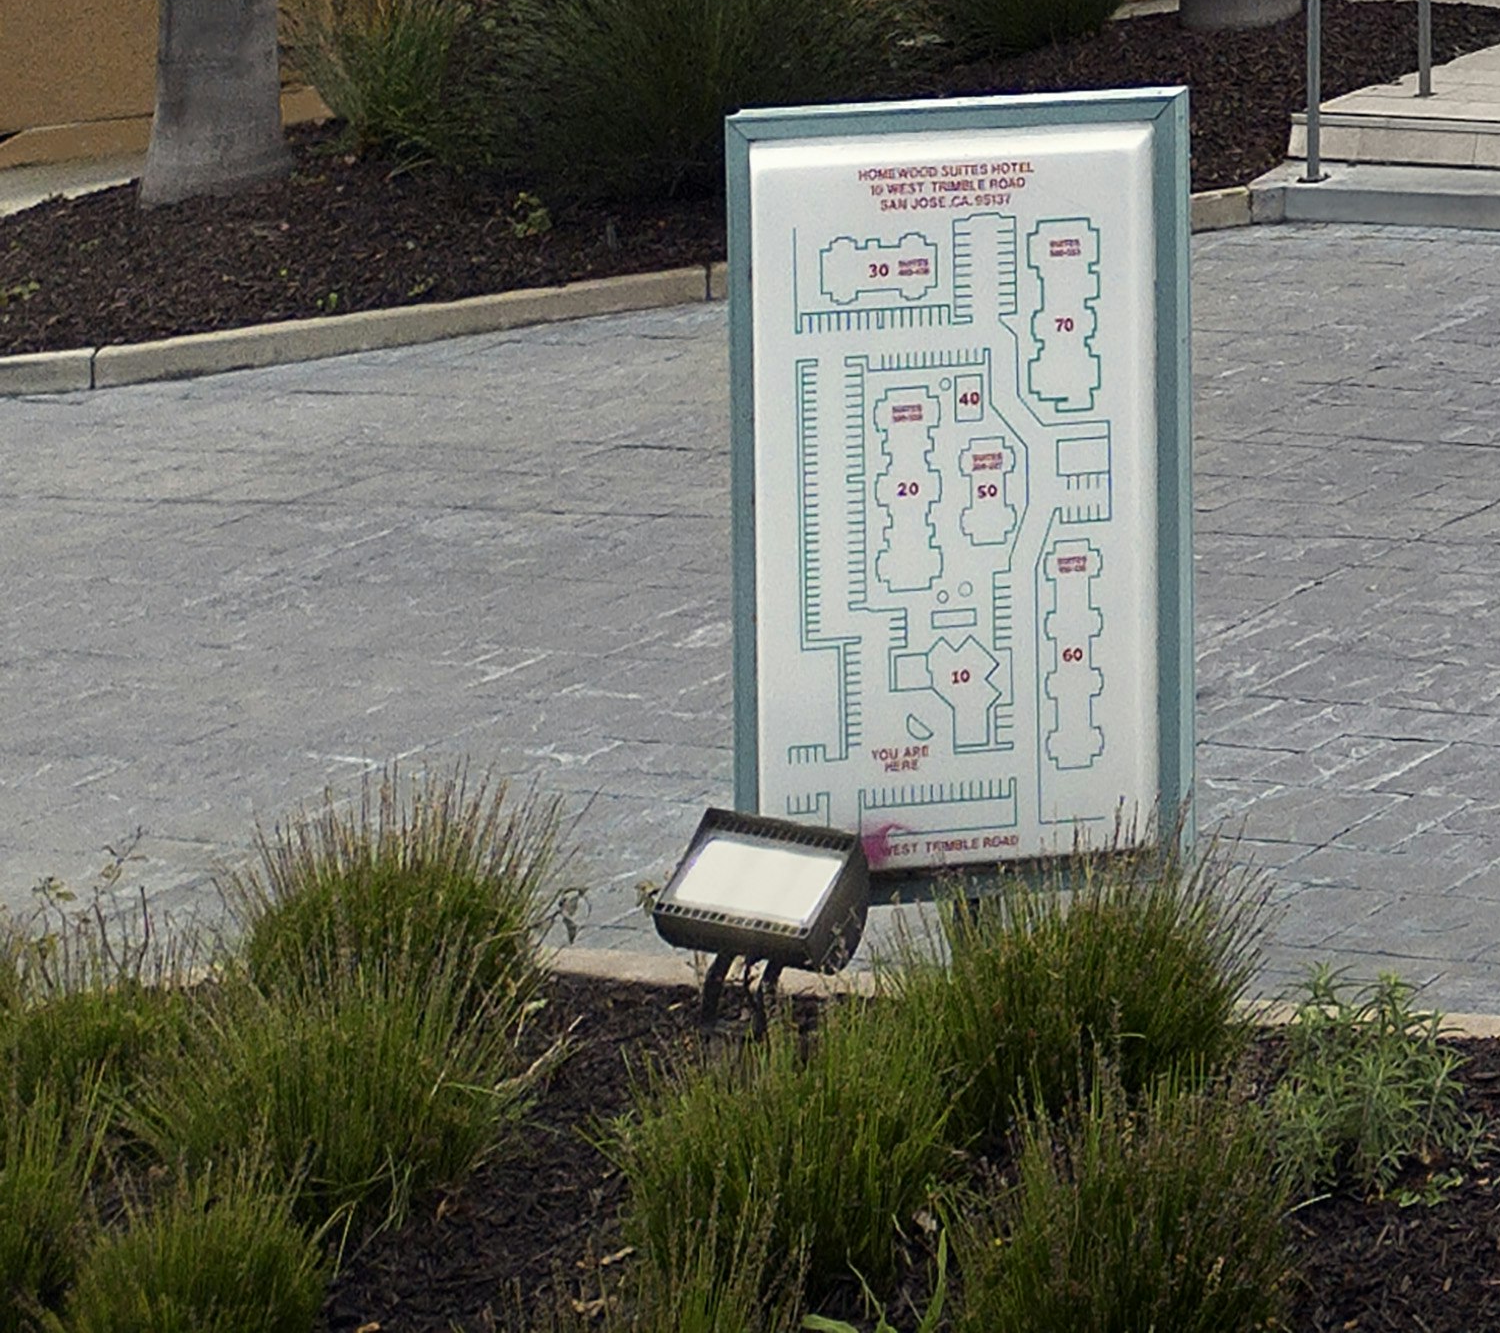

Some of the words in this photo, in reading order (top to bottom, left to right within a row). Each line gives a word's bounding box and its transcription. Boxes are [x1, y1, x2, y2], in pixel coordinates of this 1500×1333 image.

[941, 163, 988, 178] SUITES
[991, 161, 1034, 175] HOTEL
[870, 184, 884, 196] 10
[886, 181, 925, 195] WEST
[989, 176, 1026, 190] ROAD
[880, 198, 907, 212] SAN
[868, 263, 889, 279] 30
[1055, 317, 1075, 332] 70
[958, 391, 980, 406] 40
[896, 482, 920, 496] 20
[977, 484, 998, 499] 50
[1062, 647, 1083, 662] 60
[950, 669, 971, 684] 10
[871, 748, 899, 761] YOU
[983, 834, 1019, 848] ROAD
